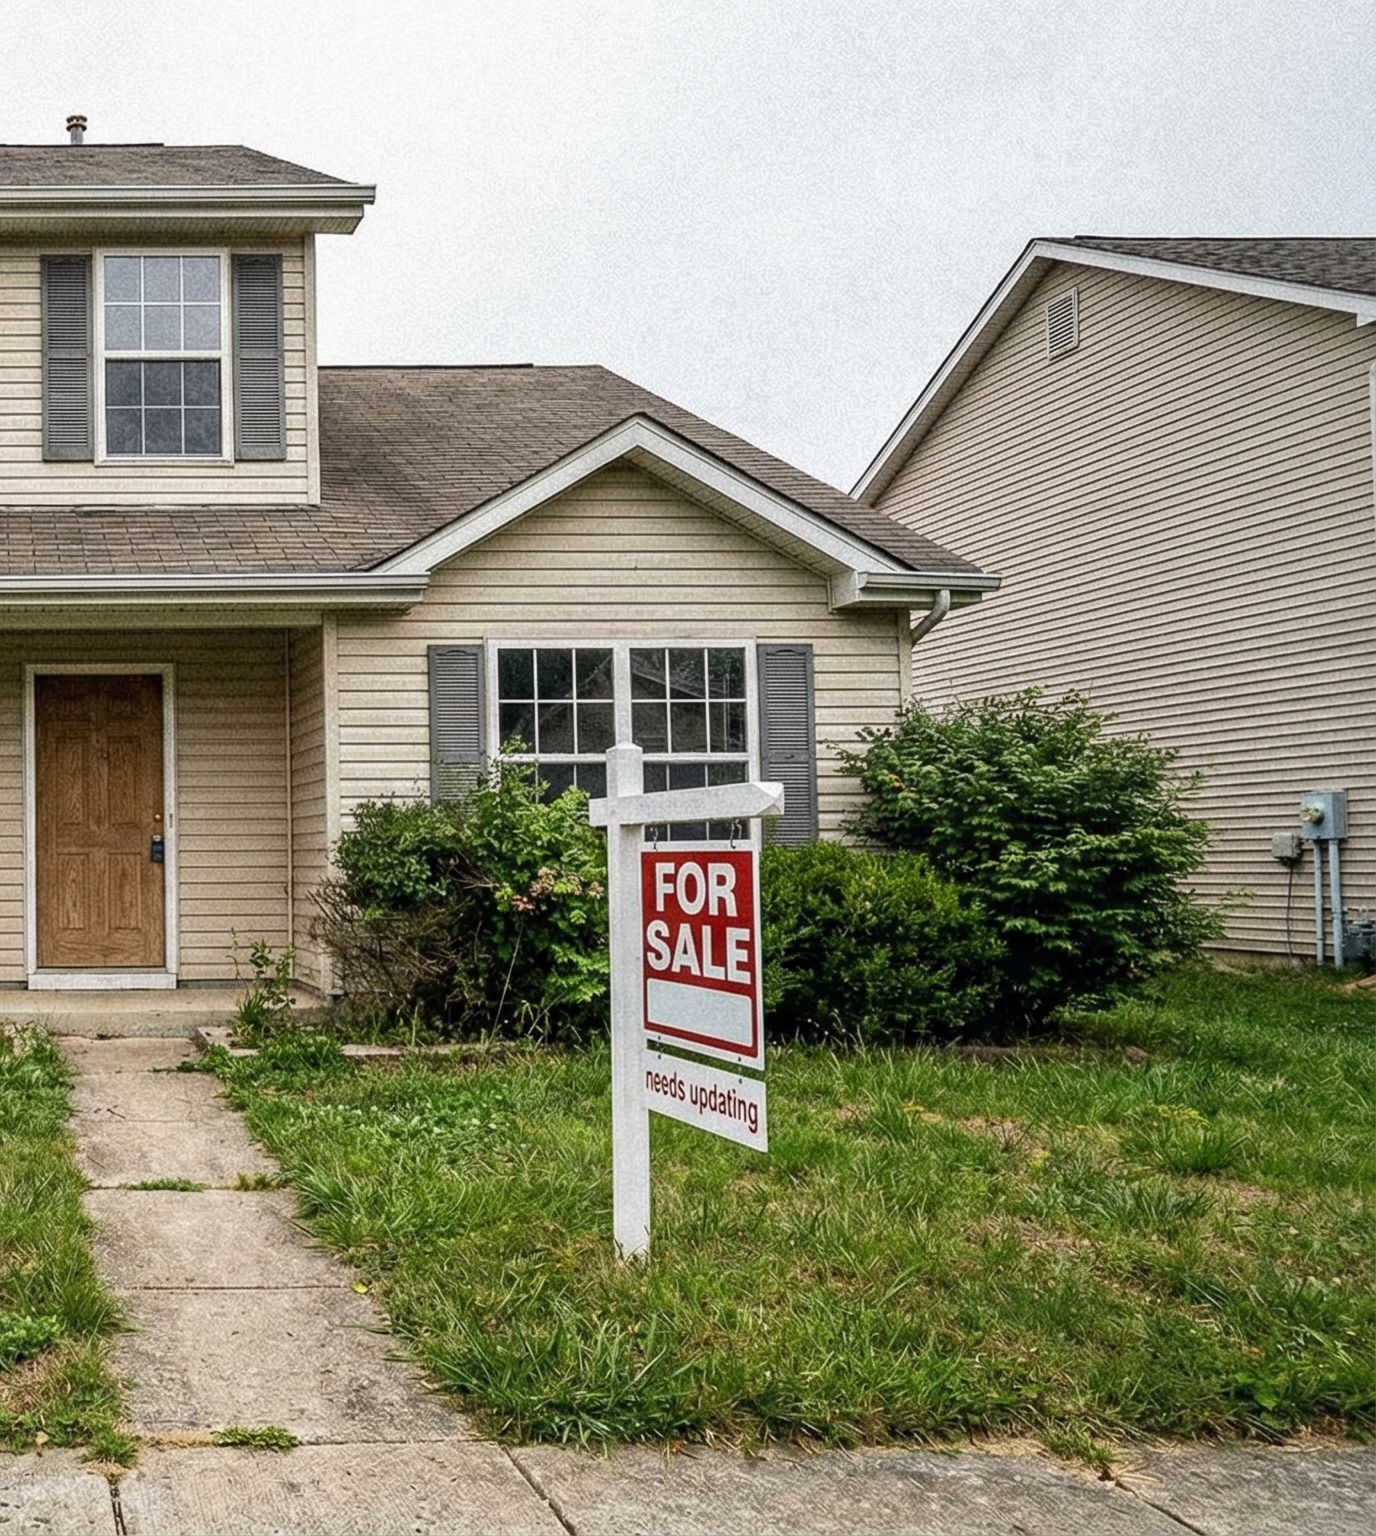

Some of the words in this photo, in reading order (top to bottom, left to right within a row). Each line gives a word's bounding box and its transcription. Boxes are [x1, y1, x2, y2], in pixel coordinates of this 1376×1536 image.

[655, 861, 738, 918] FOR
[646, 919, 751, 985] SALE
[646, 1070, 686, 1101] needs
[690, 1083, 758, 1134] updating
